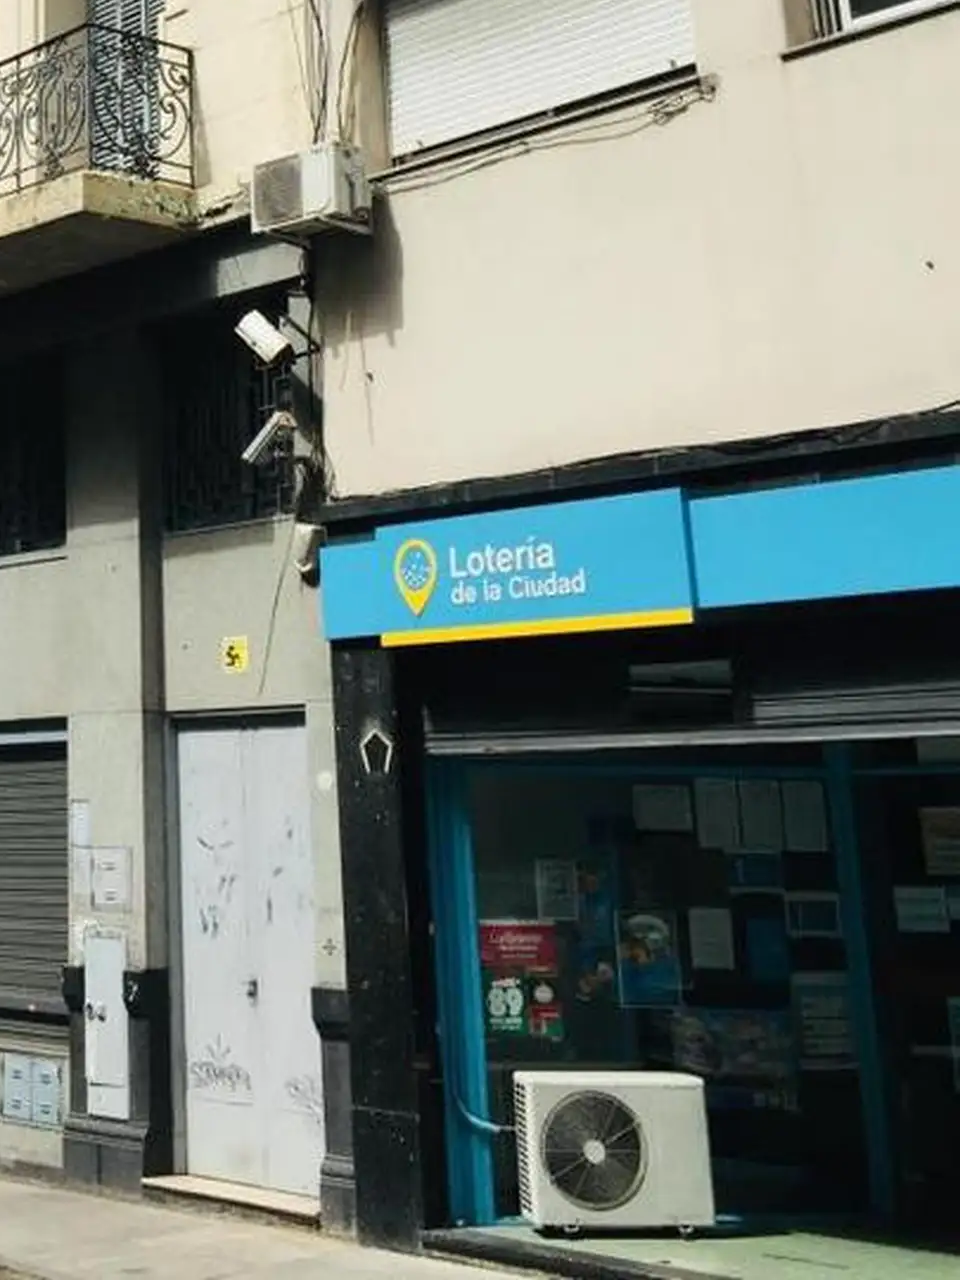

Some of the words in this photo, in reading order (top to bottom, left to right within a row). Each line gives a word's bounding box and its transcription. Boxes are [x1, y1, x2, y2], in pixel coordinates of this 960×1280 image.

[449, 537, 554, 578] Lotería
[450, 580, 476, 605] de
[483, 578, 501, 601] la
[508, 568, 587, 599] Ciudad
